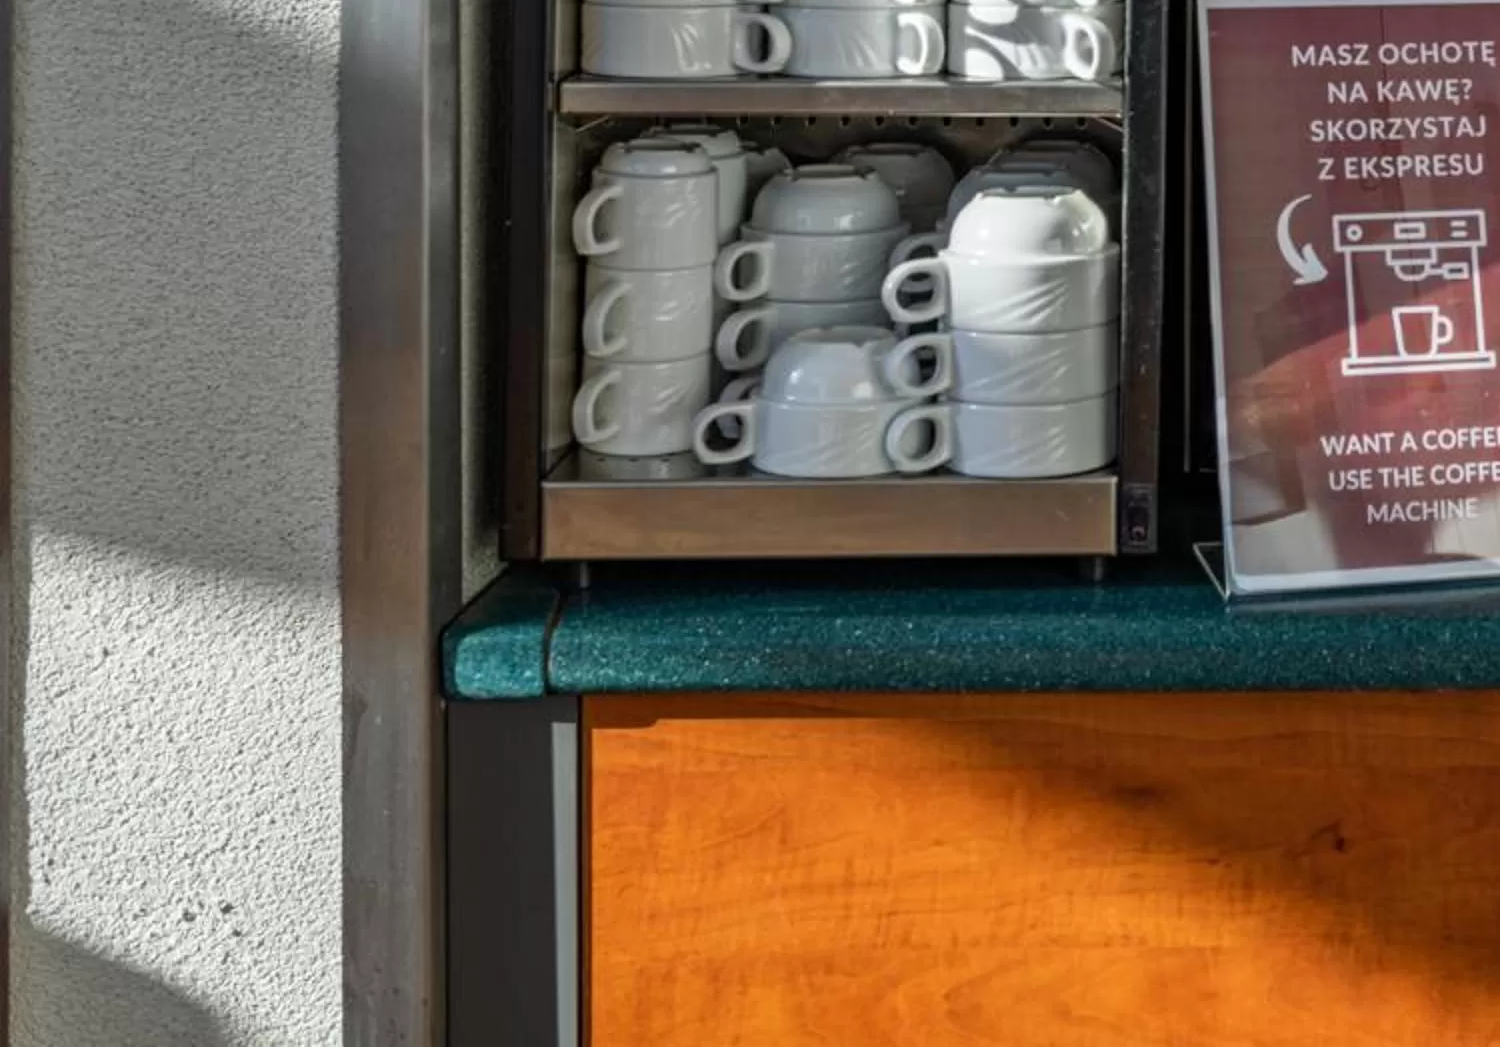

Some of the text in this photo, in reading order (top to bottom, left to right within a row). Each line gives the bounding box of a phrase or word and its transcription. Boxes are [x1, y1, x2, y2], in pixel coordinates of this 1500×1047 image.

[1291, 40, 1496, 68] MASZ OCHOTĘ
[1327, 78, 1473, 106] NA KAWĘ?
[1310, 116, 1487, 142] SKORZYSTAJ
[1318, 153, 1484, 180] Z EKSPRESU
[1320, 431, 1395, 457] WANT
[1400, 430, 1418, 452] A
[1328, 467, 1373, 491] USE
[1379, 464, 1424, 489] THE
[1366, 499, 1480, 524] MACHINE
